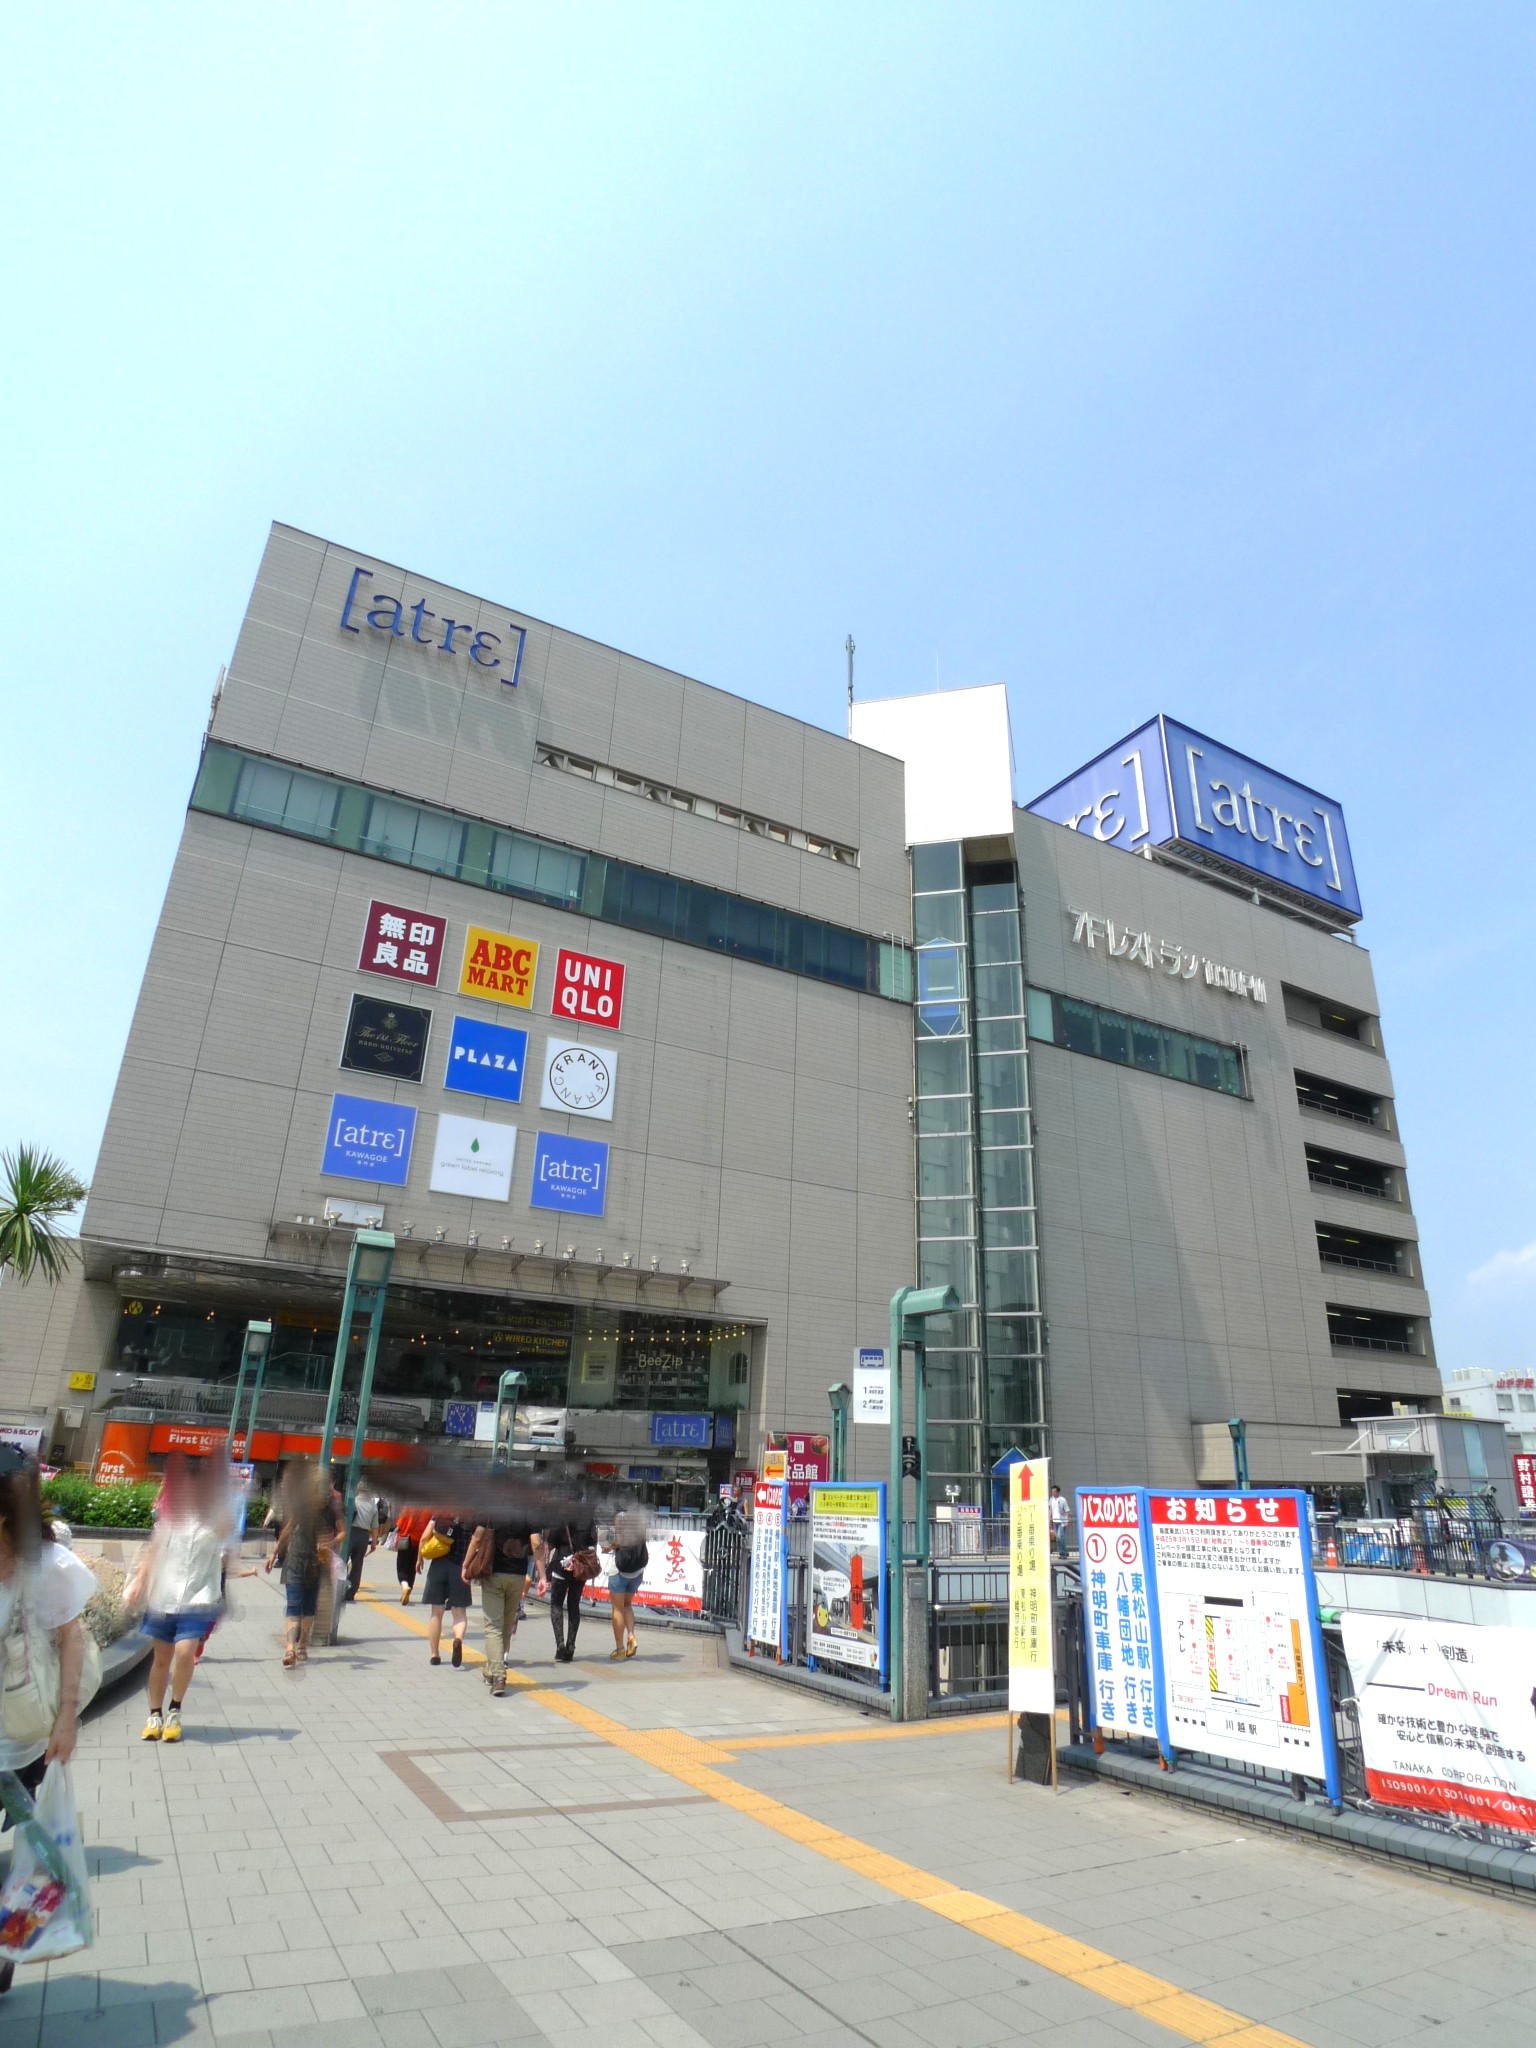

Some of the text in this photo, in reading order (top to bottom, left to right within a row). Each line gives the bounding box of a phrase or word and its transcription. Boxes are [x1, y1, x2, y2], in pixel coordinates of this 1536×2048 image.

[378, 912, 435, 947] 無印
[372, 942, 429, 976] 良品
[470, 938, 532, 976] ABC
[466, 965, 528, 997] MART
[564, 958, 612, 991] UNI
[561, 987, 614, 1018] QLO
[453, 1046, 518, 1073] PLAZA
[345, 1150, 388, 1163] KAWAGOE
[550, 1184, 587, 1196] KAWAGOE
[504, 1333, 569, 1348] WIRED KITCHEN
[638, 1353, 683, 1370] BeeZip
[169, 1433, 198, 1444] First
[100, 1461, 125, 1474] First
[1083, 1494, 1138, 1522] バスのりば
[1166, 1498, 1279, 1523] お知らせ
[1090, 1569, 1115, 1722] 神明町車庫 行き
[1116, 1571, 1137, 1724] 八幡団地 行き
[1131, 1572, 1154, 1729] 東松山駅 行き
[1177, 1620, 1186, 1653] アトレ
[1427, 1683, 1498, 1707] Dream Run
[1225, 1719, 1258, 1736] 川越駅
[1377, 1713, 1500, 1742] 確かな技術と豊かな経験で
[1397, 1730, 1526, 1762] 安心と信頼の未来を創造する
[1393, 1760, 1517, 1791] TANAKA CORPORATION
